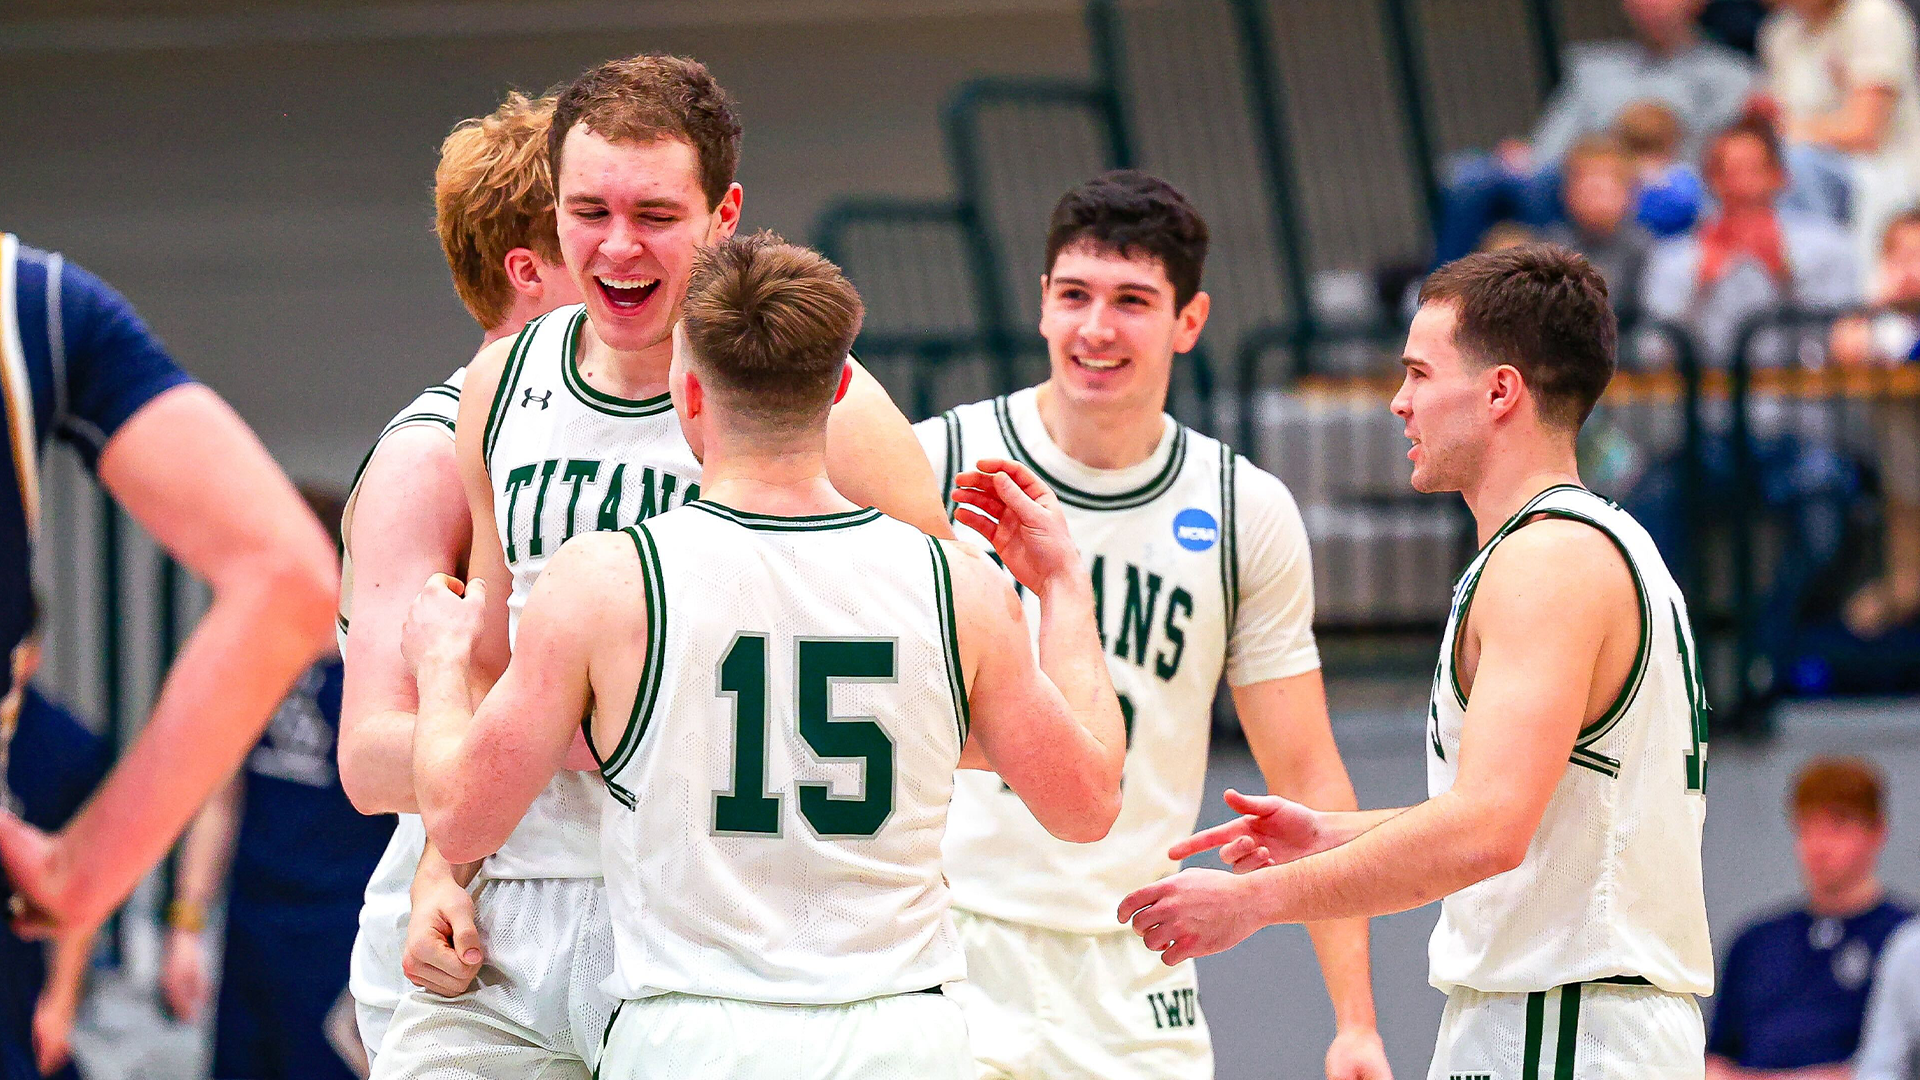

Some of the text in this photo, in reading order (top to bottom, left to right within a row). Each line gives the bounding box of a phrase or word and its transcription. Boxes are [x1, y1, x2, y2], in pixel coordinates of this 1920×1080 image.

[504, 458, 701, 564] TITAN
[711, 630, 899, 840] 15
[1147, 988, 1195, 1029] IWU
